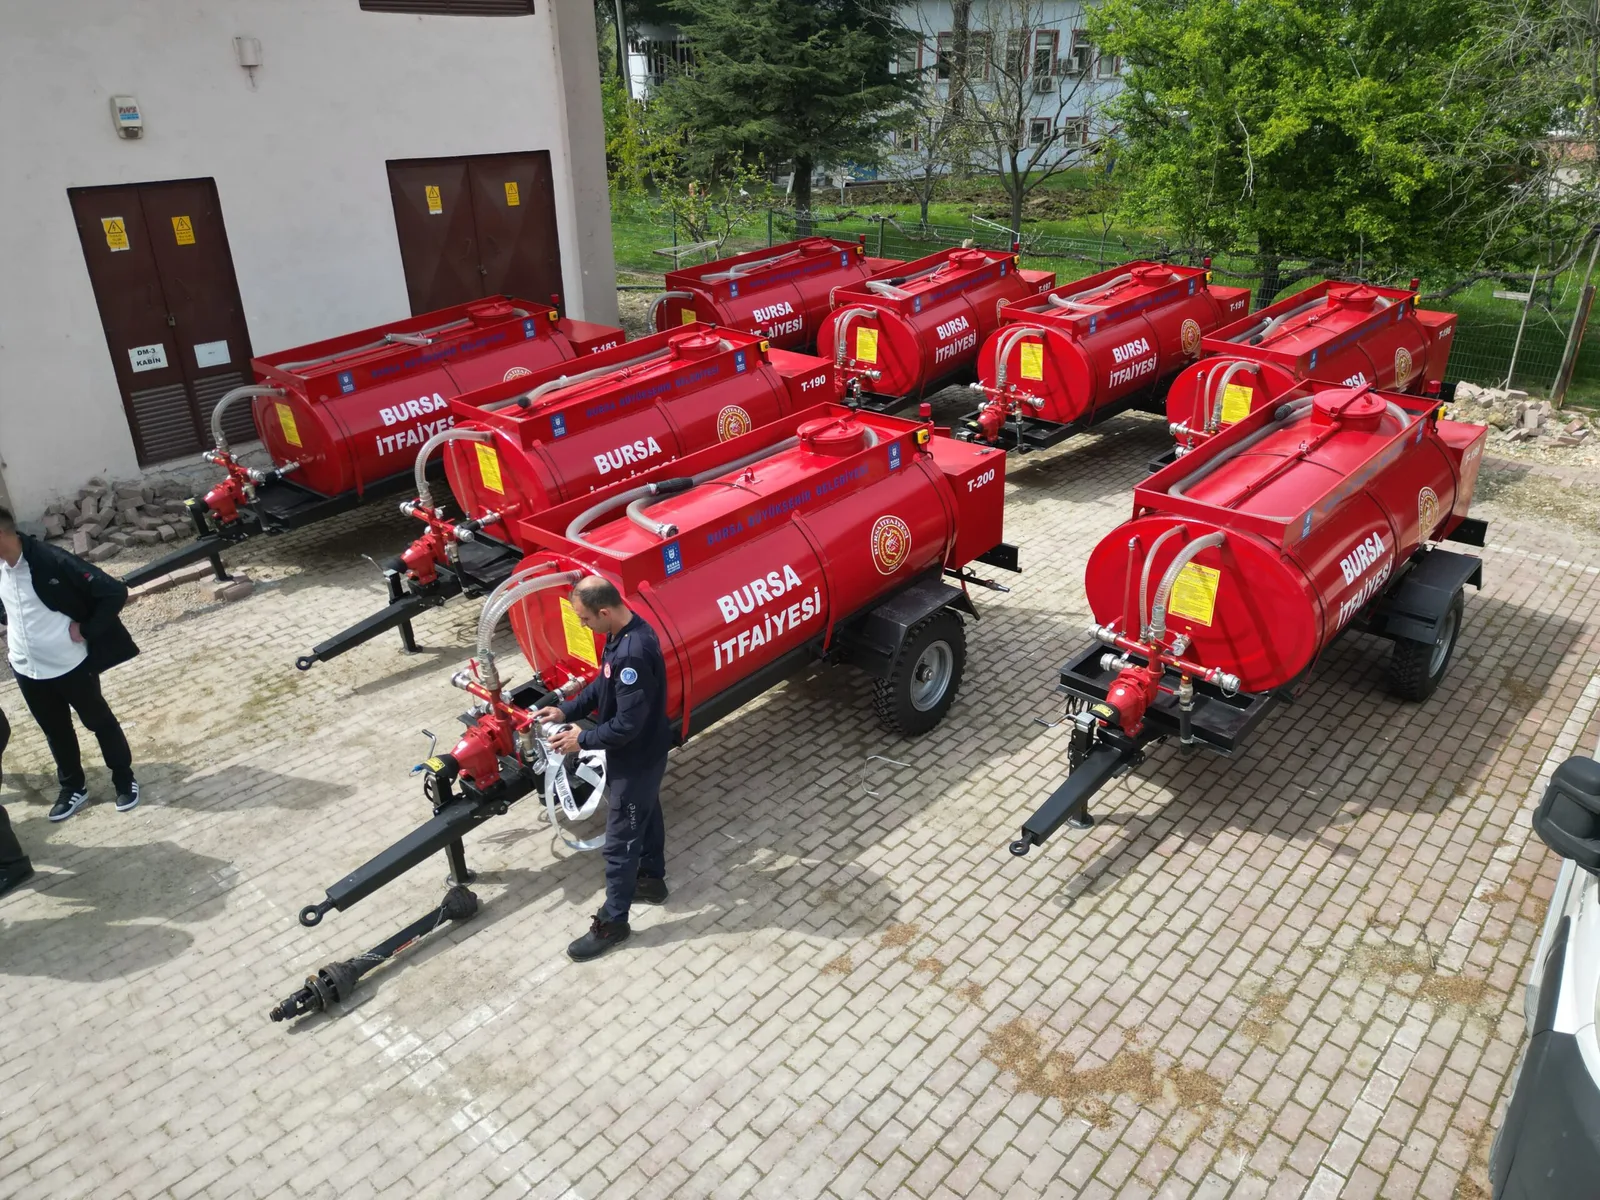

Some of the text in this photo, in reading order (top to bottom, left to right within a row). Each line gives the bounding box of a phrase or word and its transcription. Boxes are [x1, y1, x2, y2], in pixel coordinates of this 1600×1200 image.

[753, 301, 794, 323] BURSA
[936, 315, 970, 340] BURSA
[136, 357, 161, 366] KABİN
[137, 348, 156, 356] DM-3
[935, 328, 976, 364] İTFAİYESİ
[1112, 337, 1150, 363] BURSA
[800, 374, 826, 392] T-190
[1108, 352, 1157, 389] İTFAİYESİ
[379, 392, 448, 427] BURSA
[593, 436, 662, 475] BURSA
[967, 468, 995, 493] T-200
[707, 521, 744, 547] BURSA
[816, 462, 870, 497] BELEDİYESİ
[1339, 531, 1386, 586] BURSA
[716, 564, 802, 624] BURSA
[1335, 552, 1393, 631] İTFAİYESİ
[713, 586, 821, 671] İTFAİYESİ
